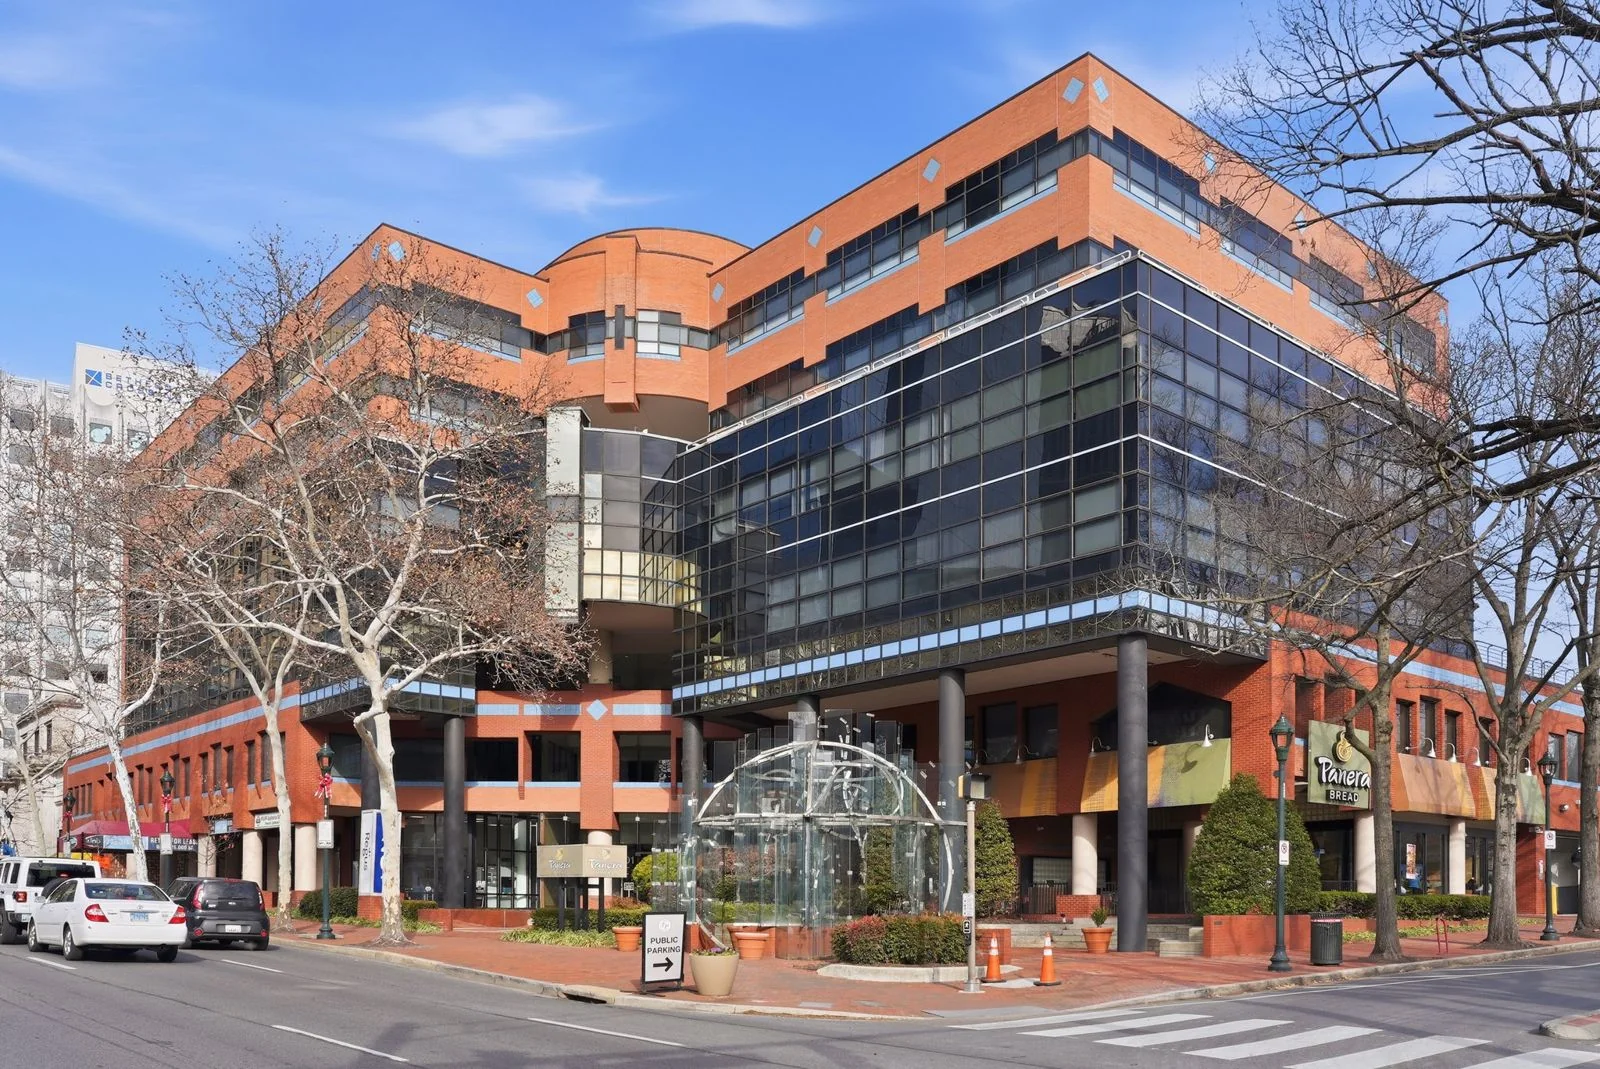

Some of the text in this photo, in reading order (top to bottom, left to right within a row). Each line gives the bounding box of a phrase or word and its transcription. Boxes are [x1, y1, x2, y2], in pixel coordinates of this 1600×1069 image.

[1318, 756, 1370, 788] Panera
[1330, 790, 1358, 802] BREAD
[362, 832, 370, 870] Regus
[647, 946, 681, 954] PARKING
